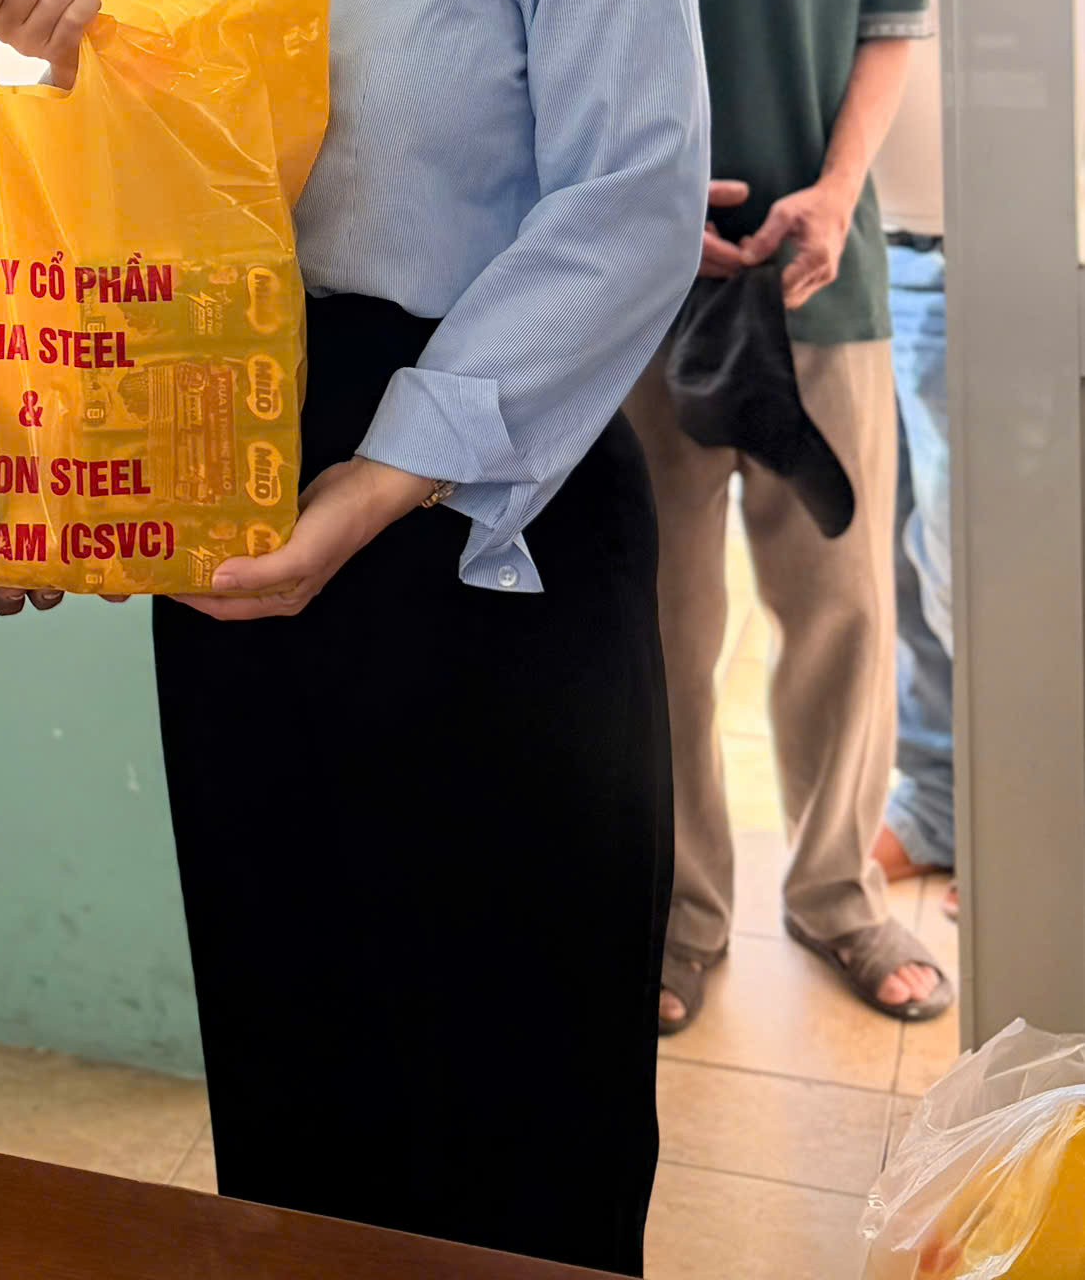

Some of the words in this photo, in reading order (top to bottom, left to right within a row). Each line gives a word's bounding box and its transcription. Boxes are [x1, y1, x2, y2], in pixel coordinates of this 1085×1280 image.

[30, 250, 66, 301] CỔ
[74, 251, 173, 304] PHẦN
[38, 327, 135, 369] STEEL
[18, 390, 43, 427] &
[254, 360, 273, 413] MILO
[50, 457, 152, 498] STEEL
[254, 447, 272, 500] MILO
[60, 520, 176, 566] (CSVC)
